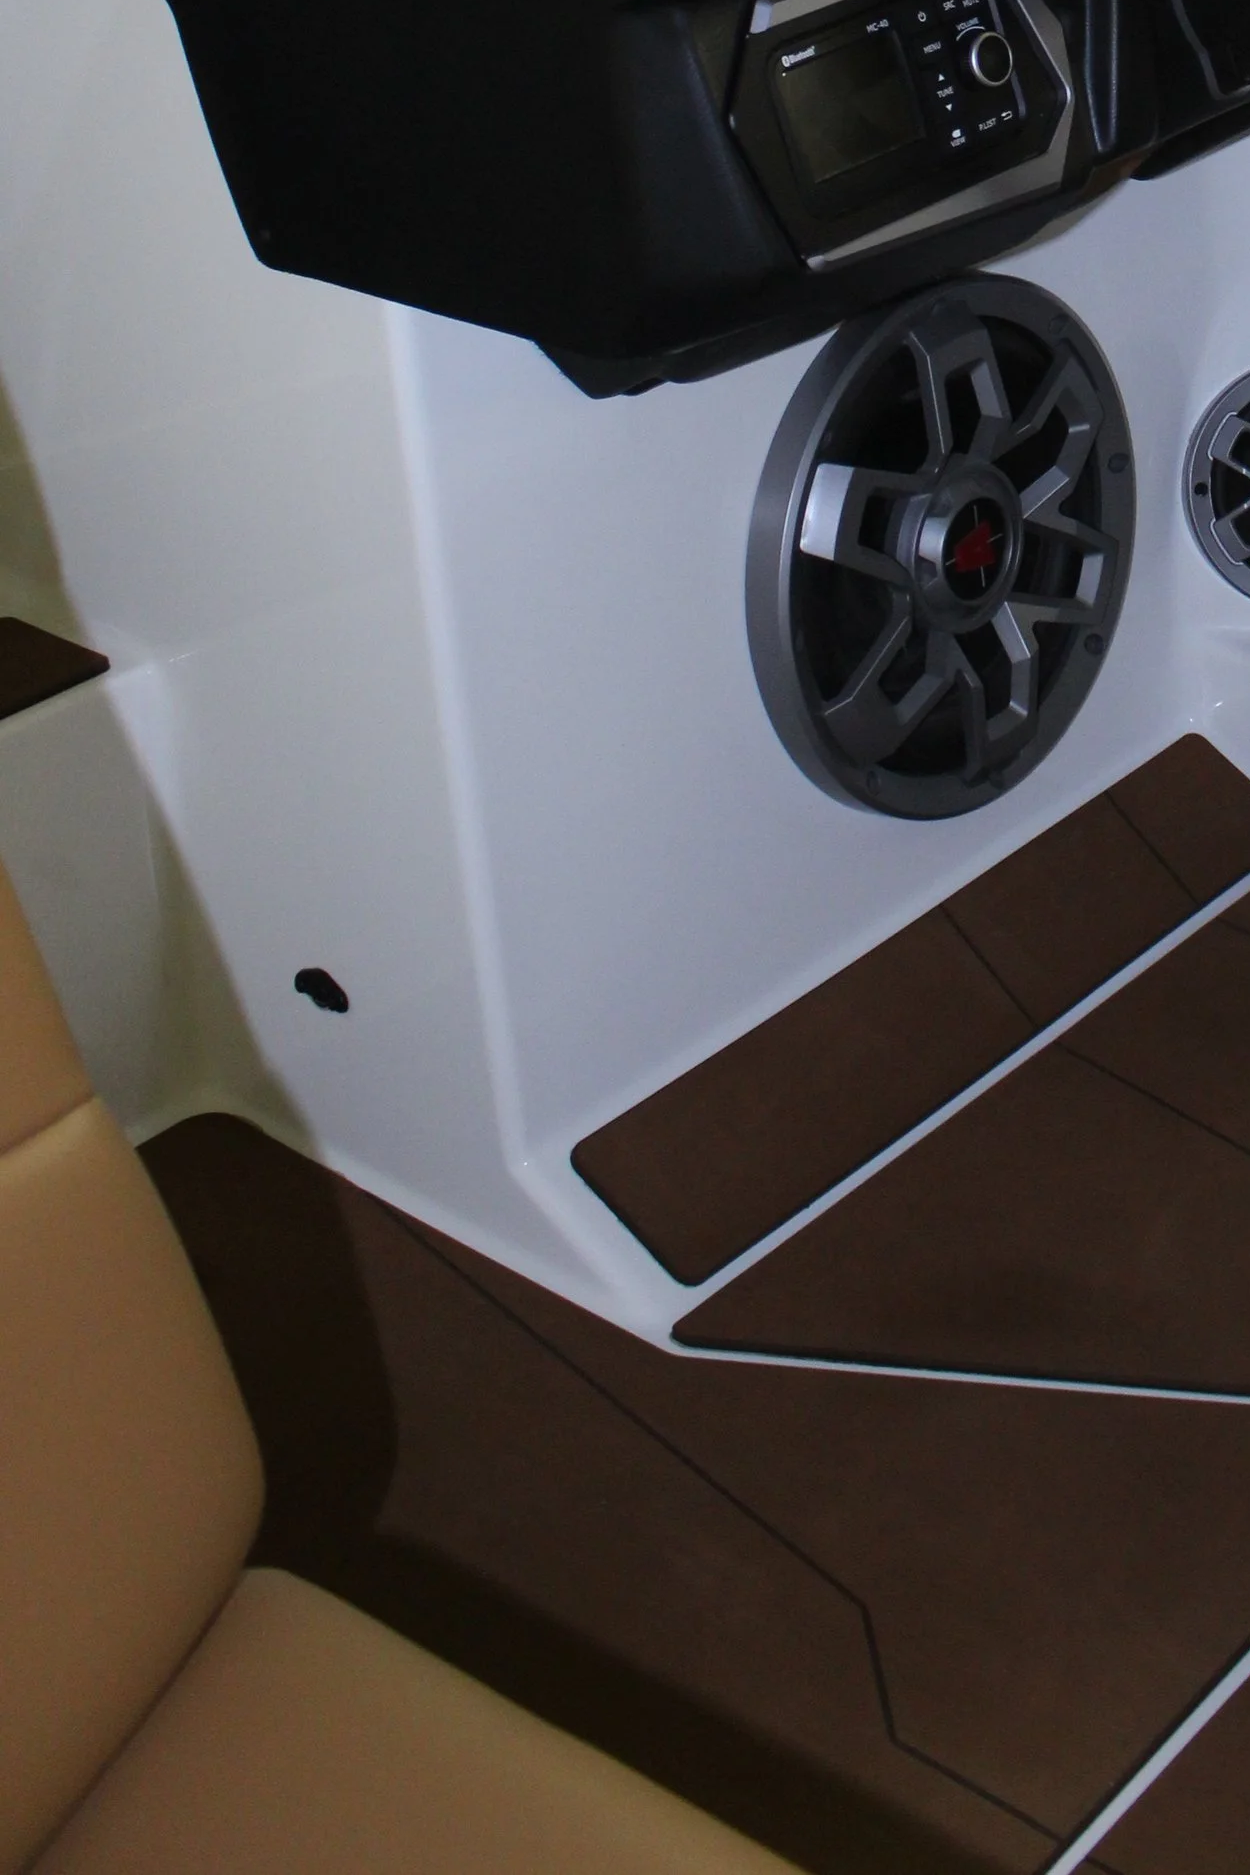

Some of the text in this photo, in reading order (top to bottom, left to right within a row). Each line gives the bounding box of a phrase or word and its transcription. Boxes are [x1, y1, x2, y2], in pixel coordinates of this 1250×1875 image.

[942, 0, 956, 11] SRC
[866, 19, 889, 33] MC-40
[923, 41, 942, 54] MENU
[937, 86, 954, 98] TUNE
[950, 136, 966, 148] VIEW
